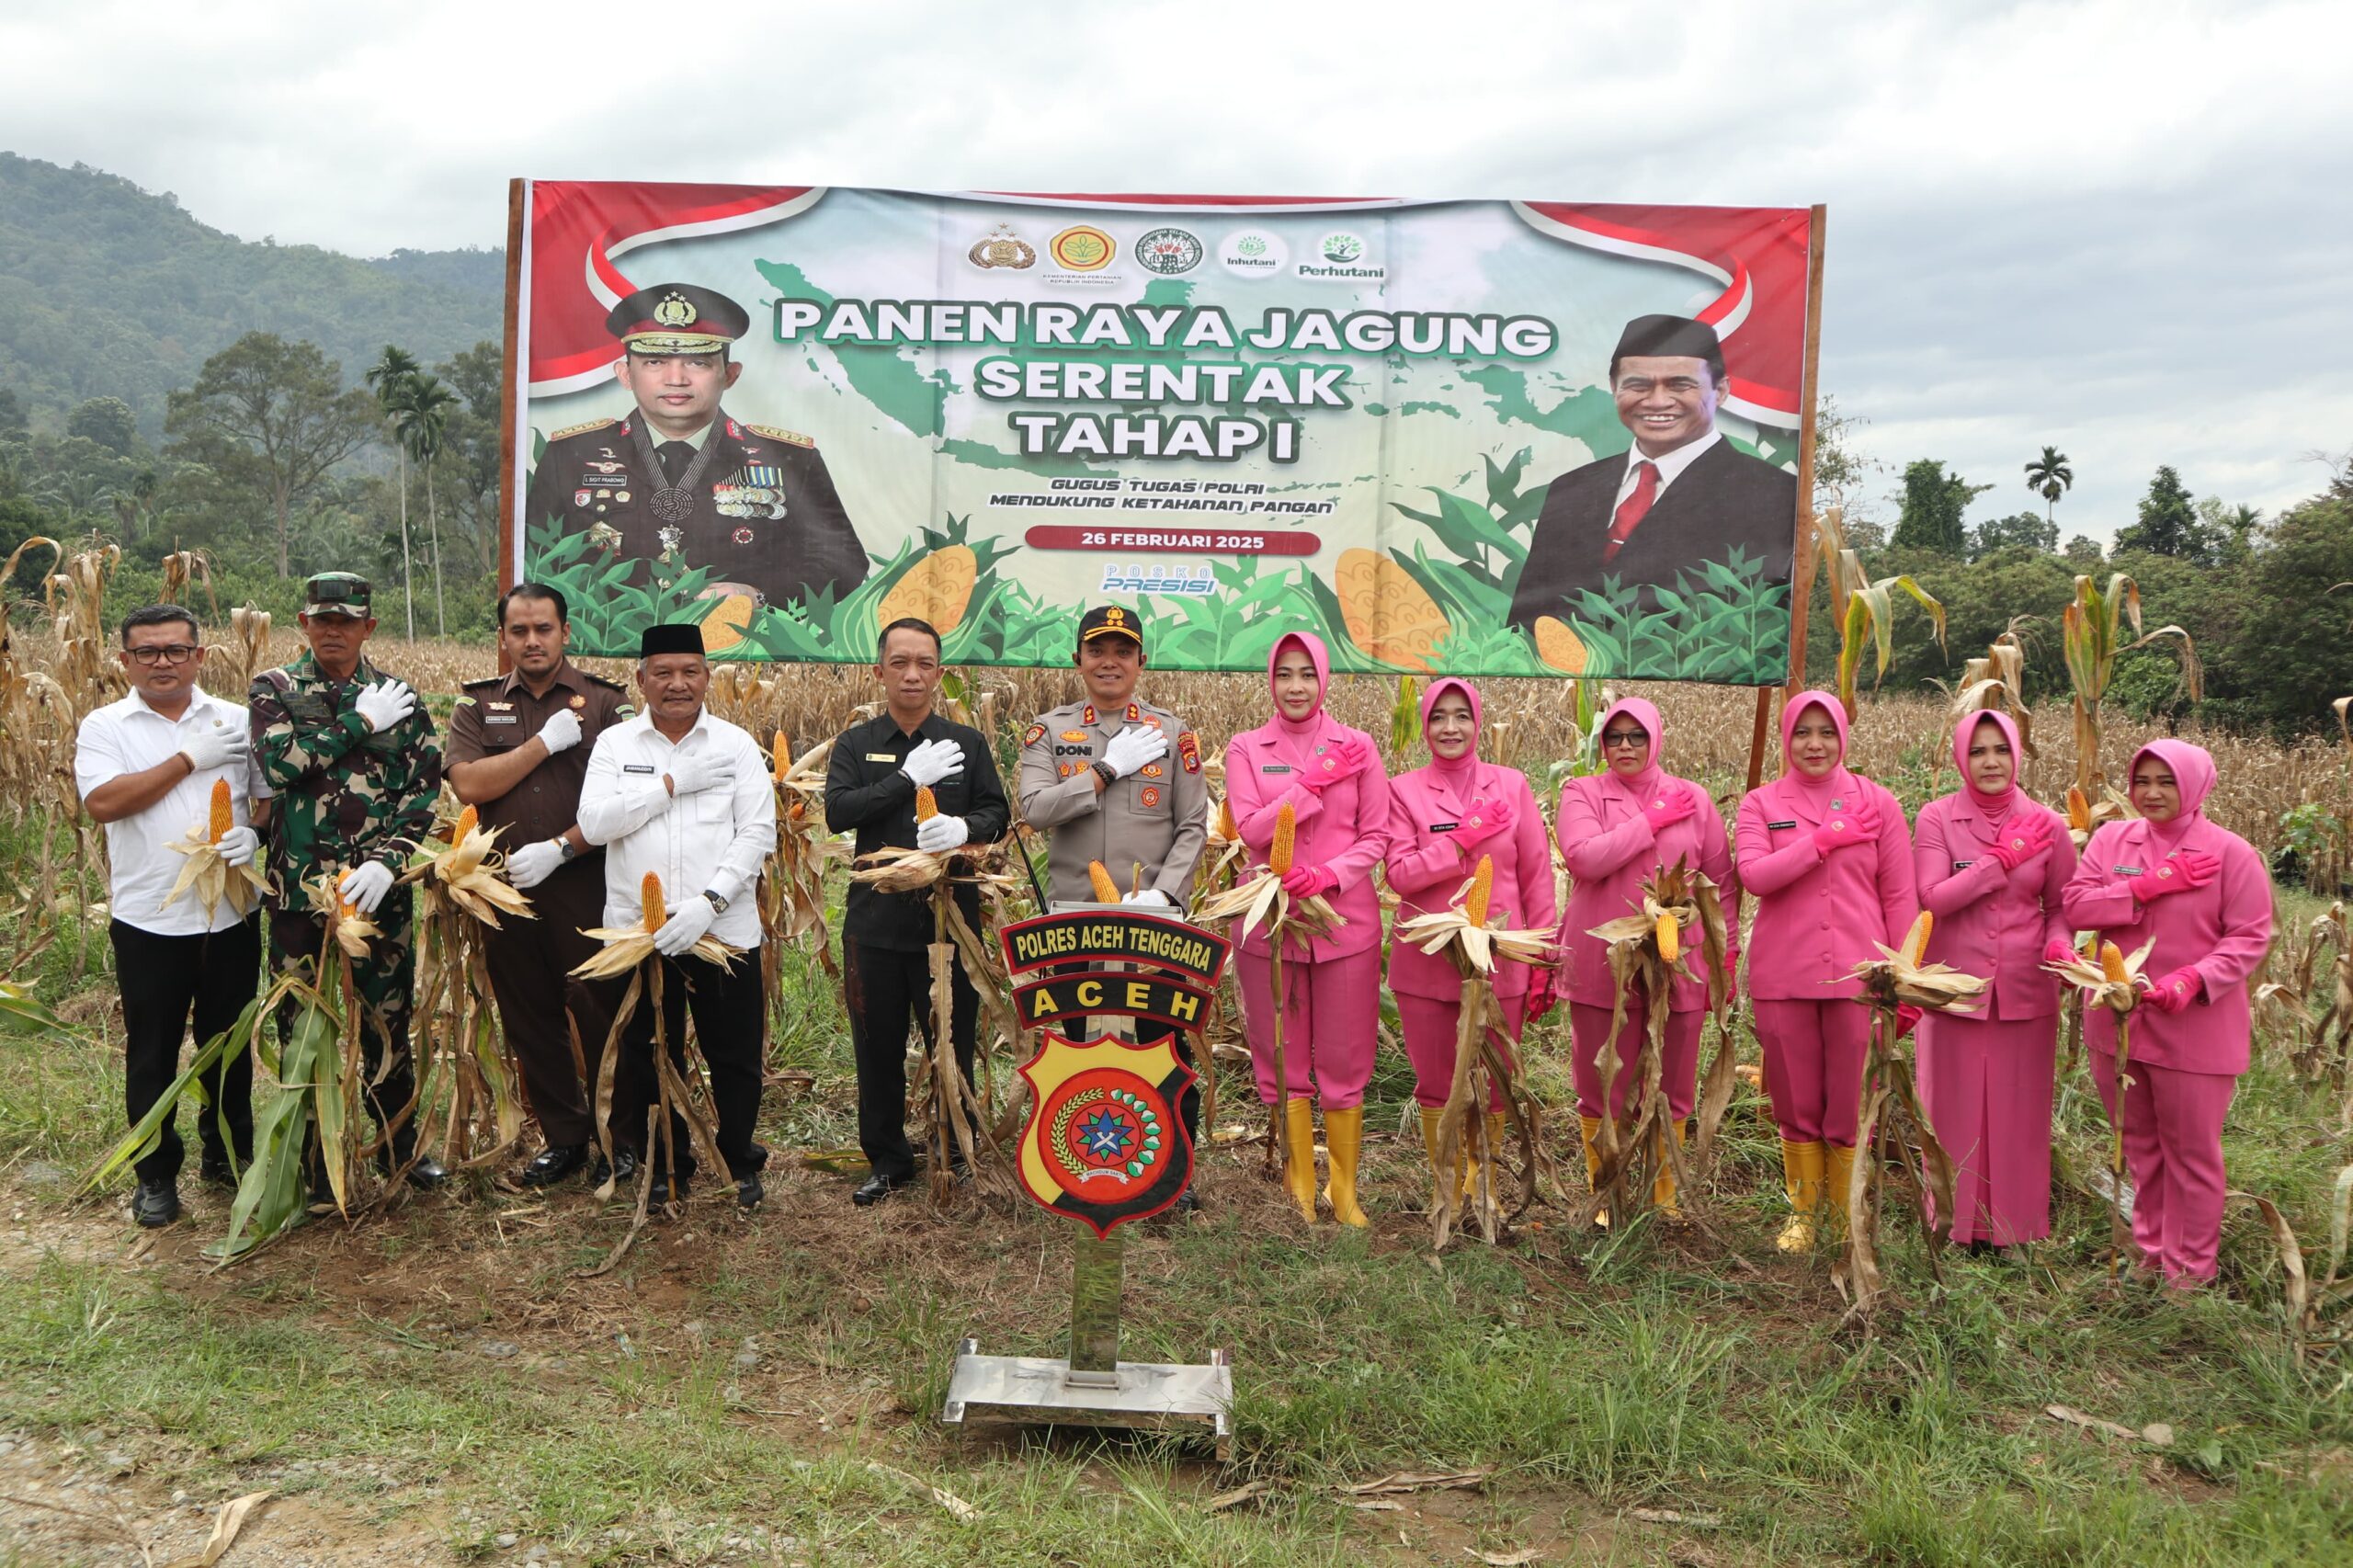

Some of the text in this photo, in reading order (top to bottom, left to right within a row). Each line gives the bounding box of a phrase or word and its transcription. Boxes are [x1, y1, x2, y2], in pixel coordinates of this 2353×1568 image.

[1227, 257, 1277, 267] Inhutani
[1298, 265, 1384, 278] Perhutani
[779, 301, 1553, 358] PANEN RAYA JAGUNG
[979, 359, 1347, 406] SERENTAK
[1014, 415, 1293, 460] TAHAP I
[1051, 479, 1265, 494] GUGUS TUGAS POLRI
[989, 494, 1333, 514] MENDUKUNG KETAHANAN PANGAN
[1081, 532, 1265, 549] 26 FEBRUARI 2025
[1106, 564, 1211, 579] POSKO
[1102, 577, 1215, 593] PRESISI
[1056, 745, 1092, 756] DONI
[1016, 926, 1212, 971] POLRES ACEH TENGGARA
[1033, 981, 1199, 1021] ACEH
